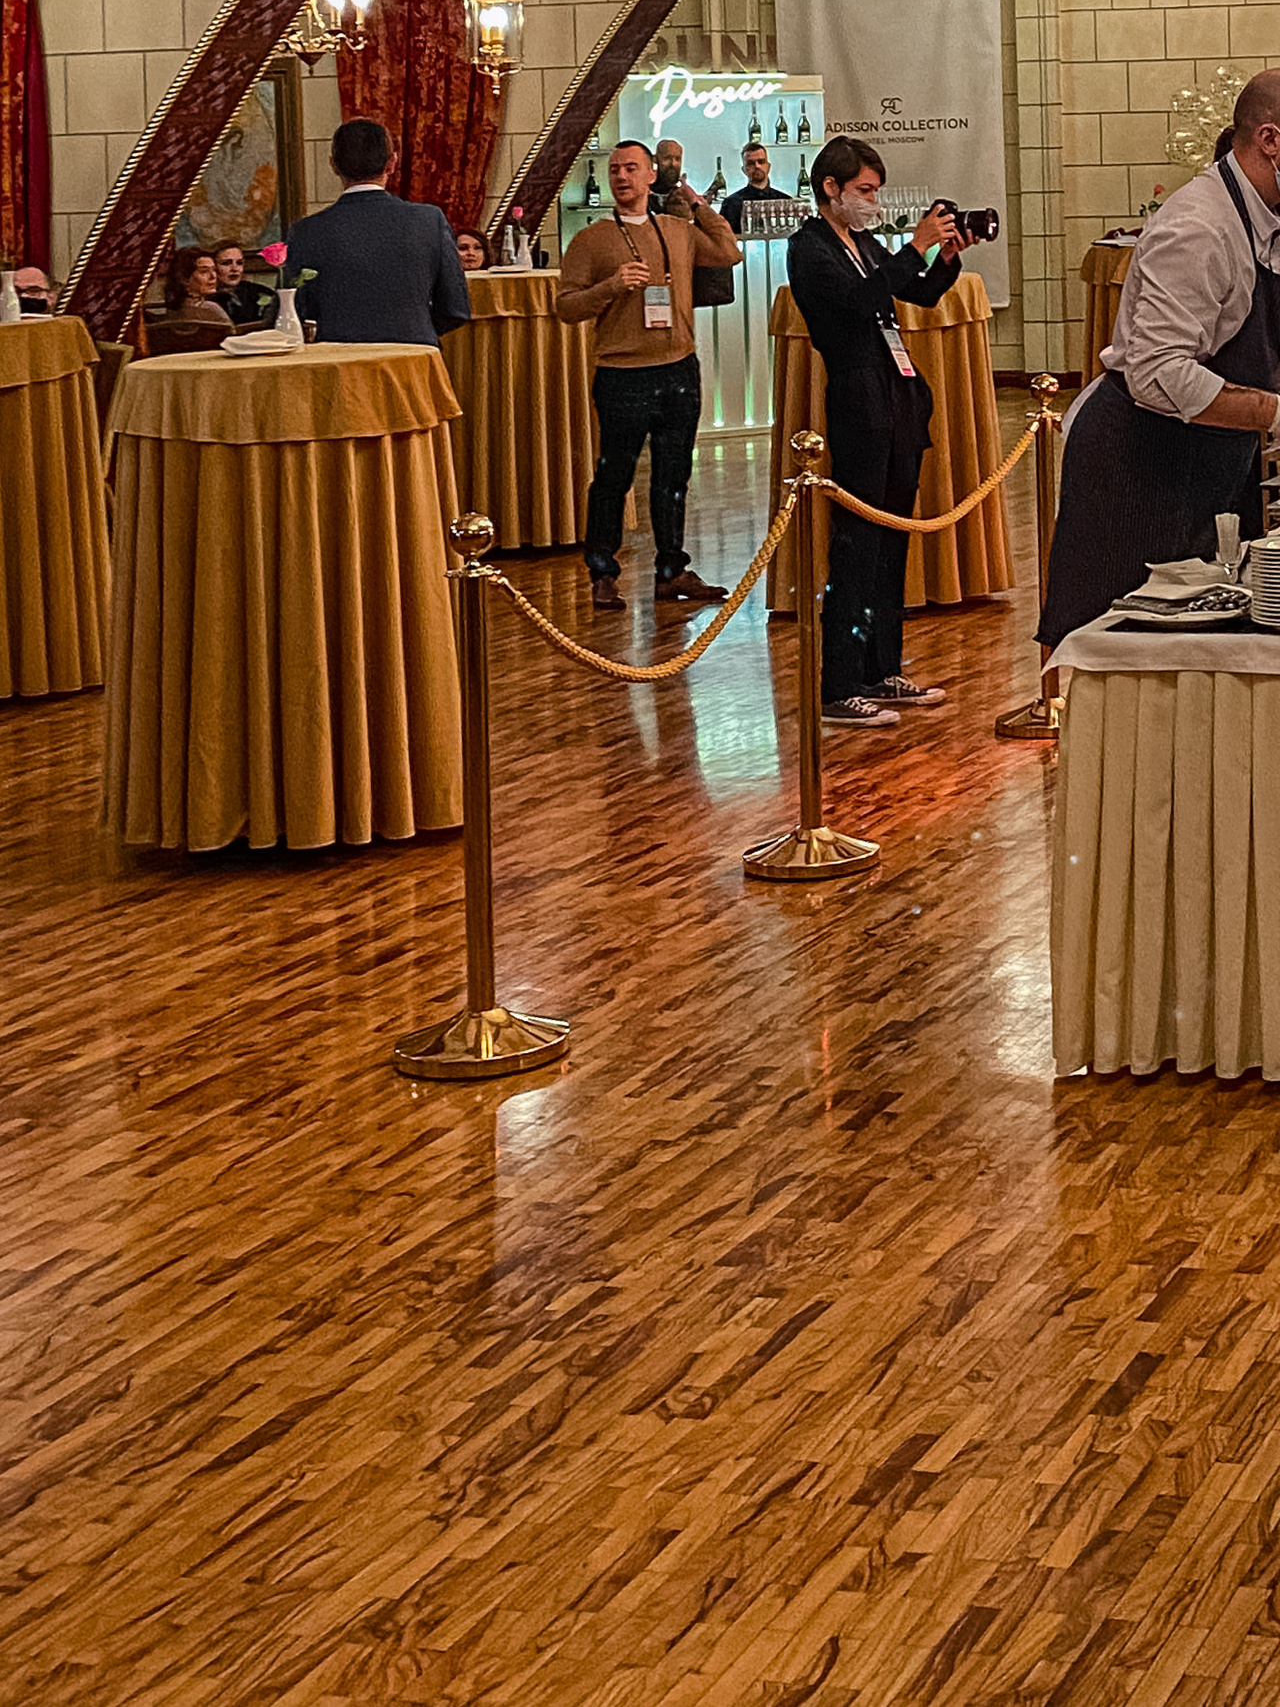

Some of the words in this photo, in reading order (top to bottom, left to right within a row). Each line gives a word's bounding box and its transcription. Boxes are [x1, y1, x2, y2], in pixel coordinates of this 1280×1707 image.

[825, 120, 879, 133] ADISSON
[882, 118, 969, 132] COLLECTION
[887, 136, 925, 144] MOSCOW
